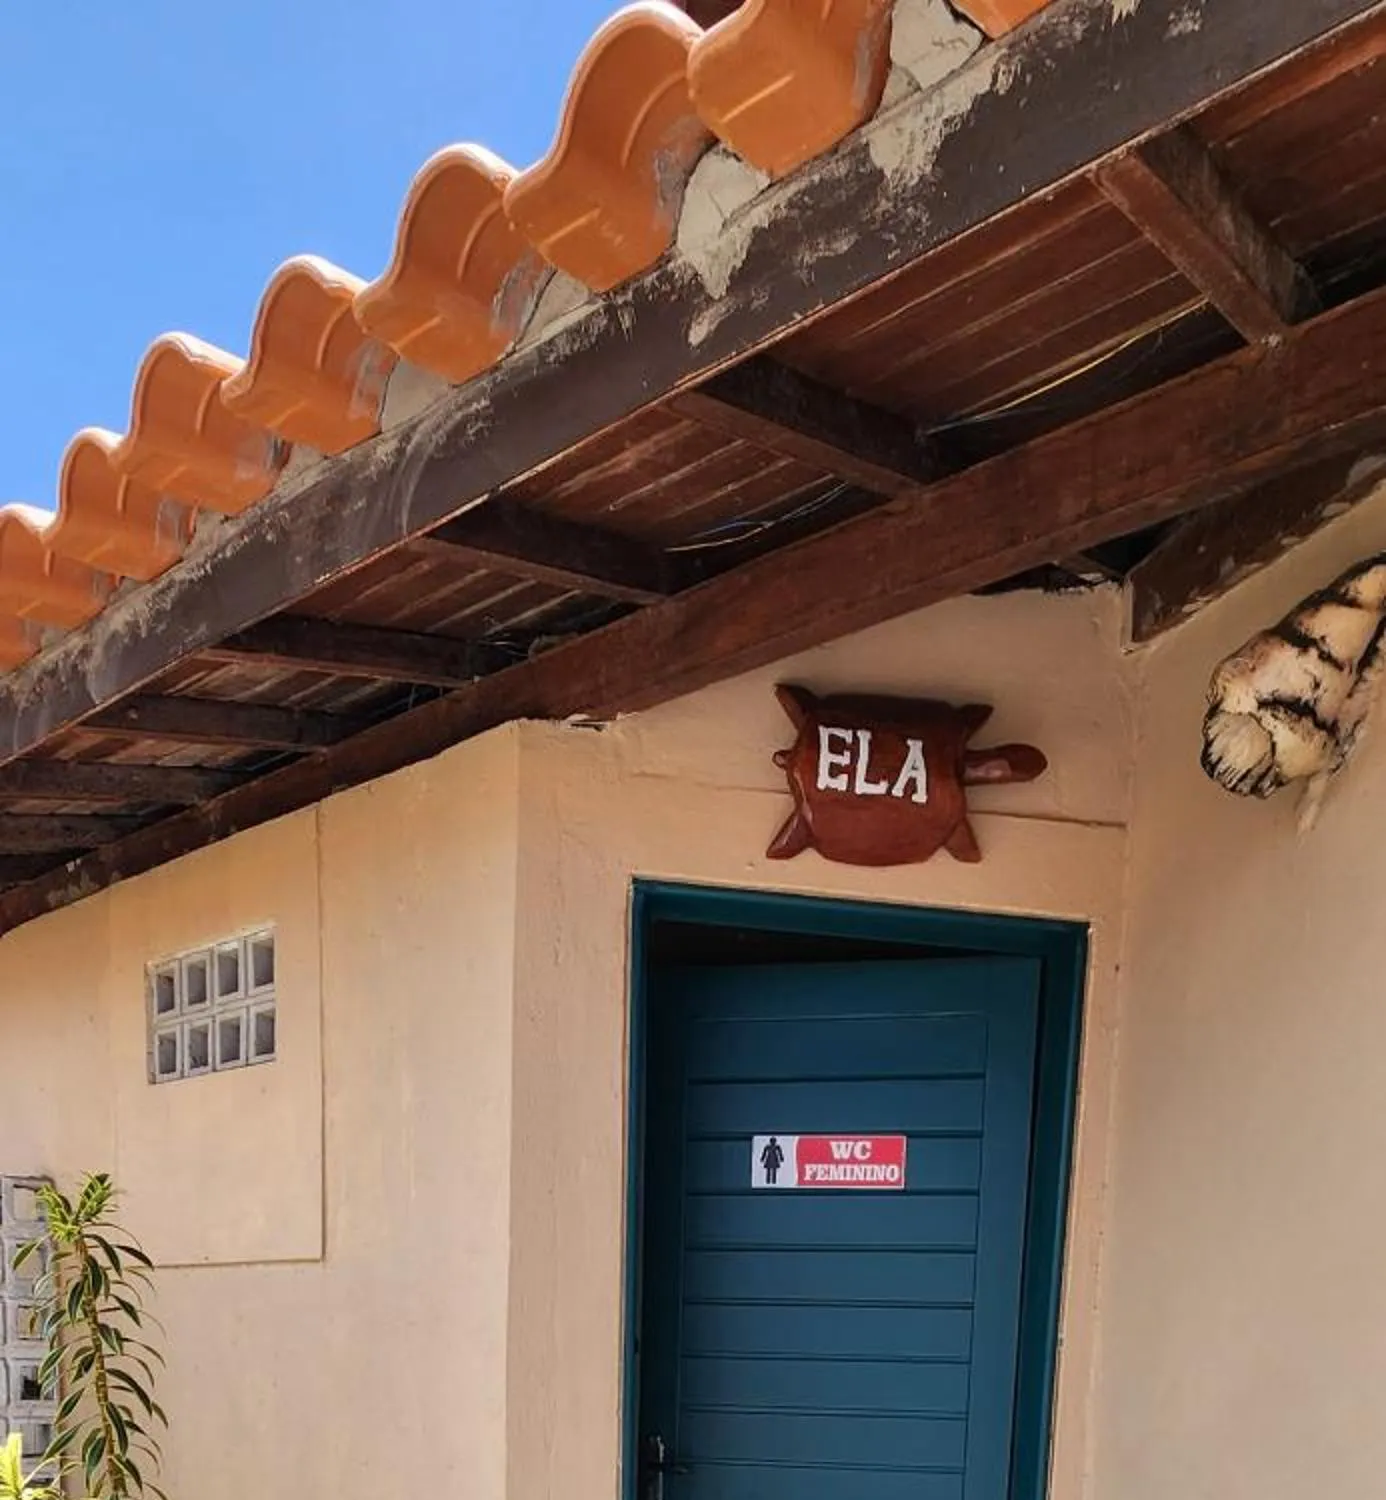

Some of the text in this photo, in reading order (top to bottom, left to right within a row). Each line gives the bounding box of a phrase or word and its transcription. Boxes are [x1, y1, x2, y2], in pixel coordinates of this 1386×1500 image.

[816, 725, 929, 804] ELA
[829, 1141, 873, 1160] WC
[803, 1163, 899, 1182] FEMININO
